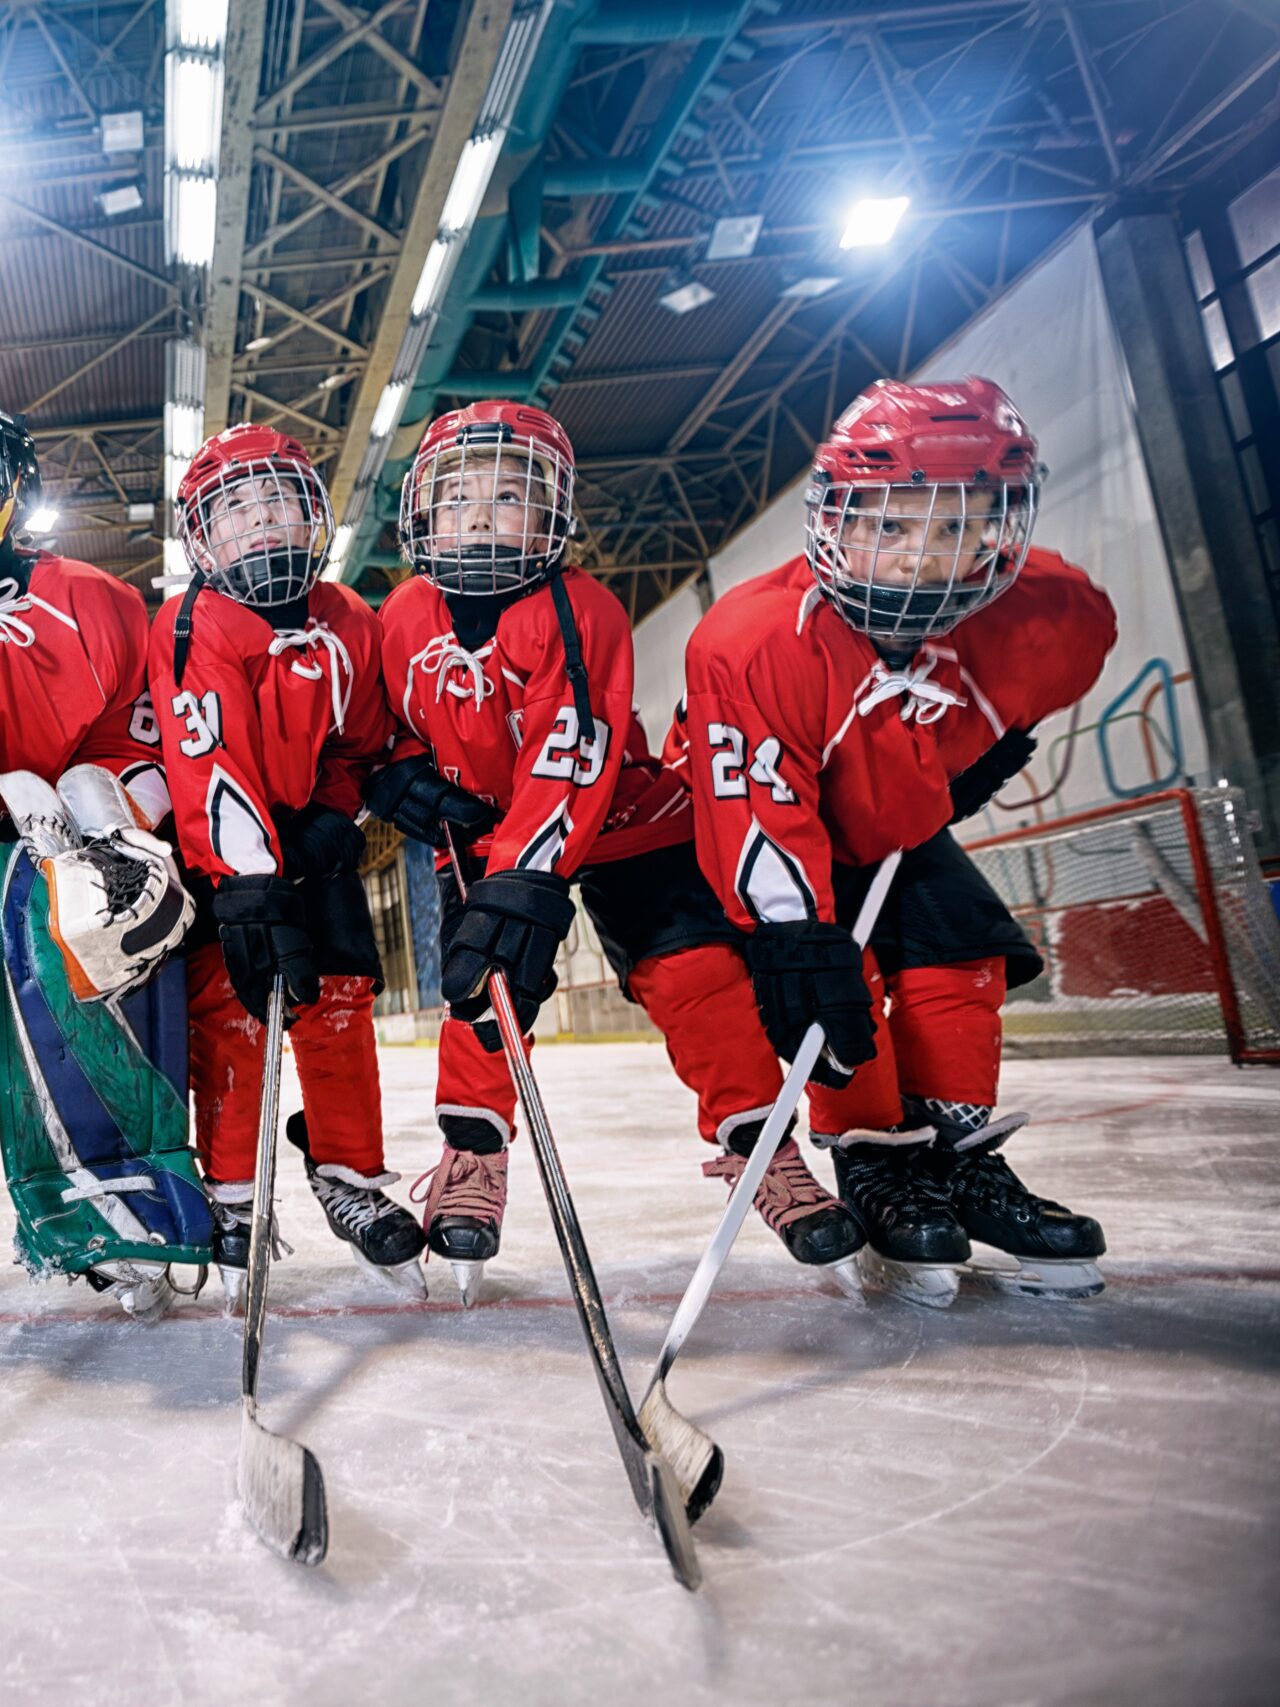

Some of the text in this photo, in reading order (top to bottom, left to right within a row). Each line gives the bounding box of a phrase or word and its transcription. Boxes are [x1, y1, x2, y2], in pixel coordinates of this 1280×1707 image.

[171, 690, 226, 759] 31
[530, 705, 612, 788] 29
[708, 723, 800, 805] 24
